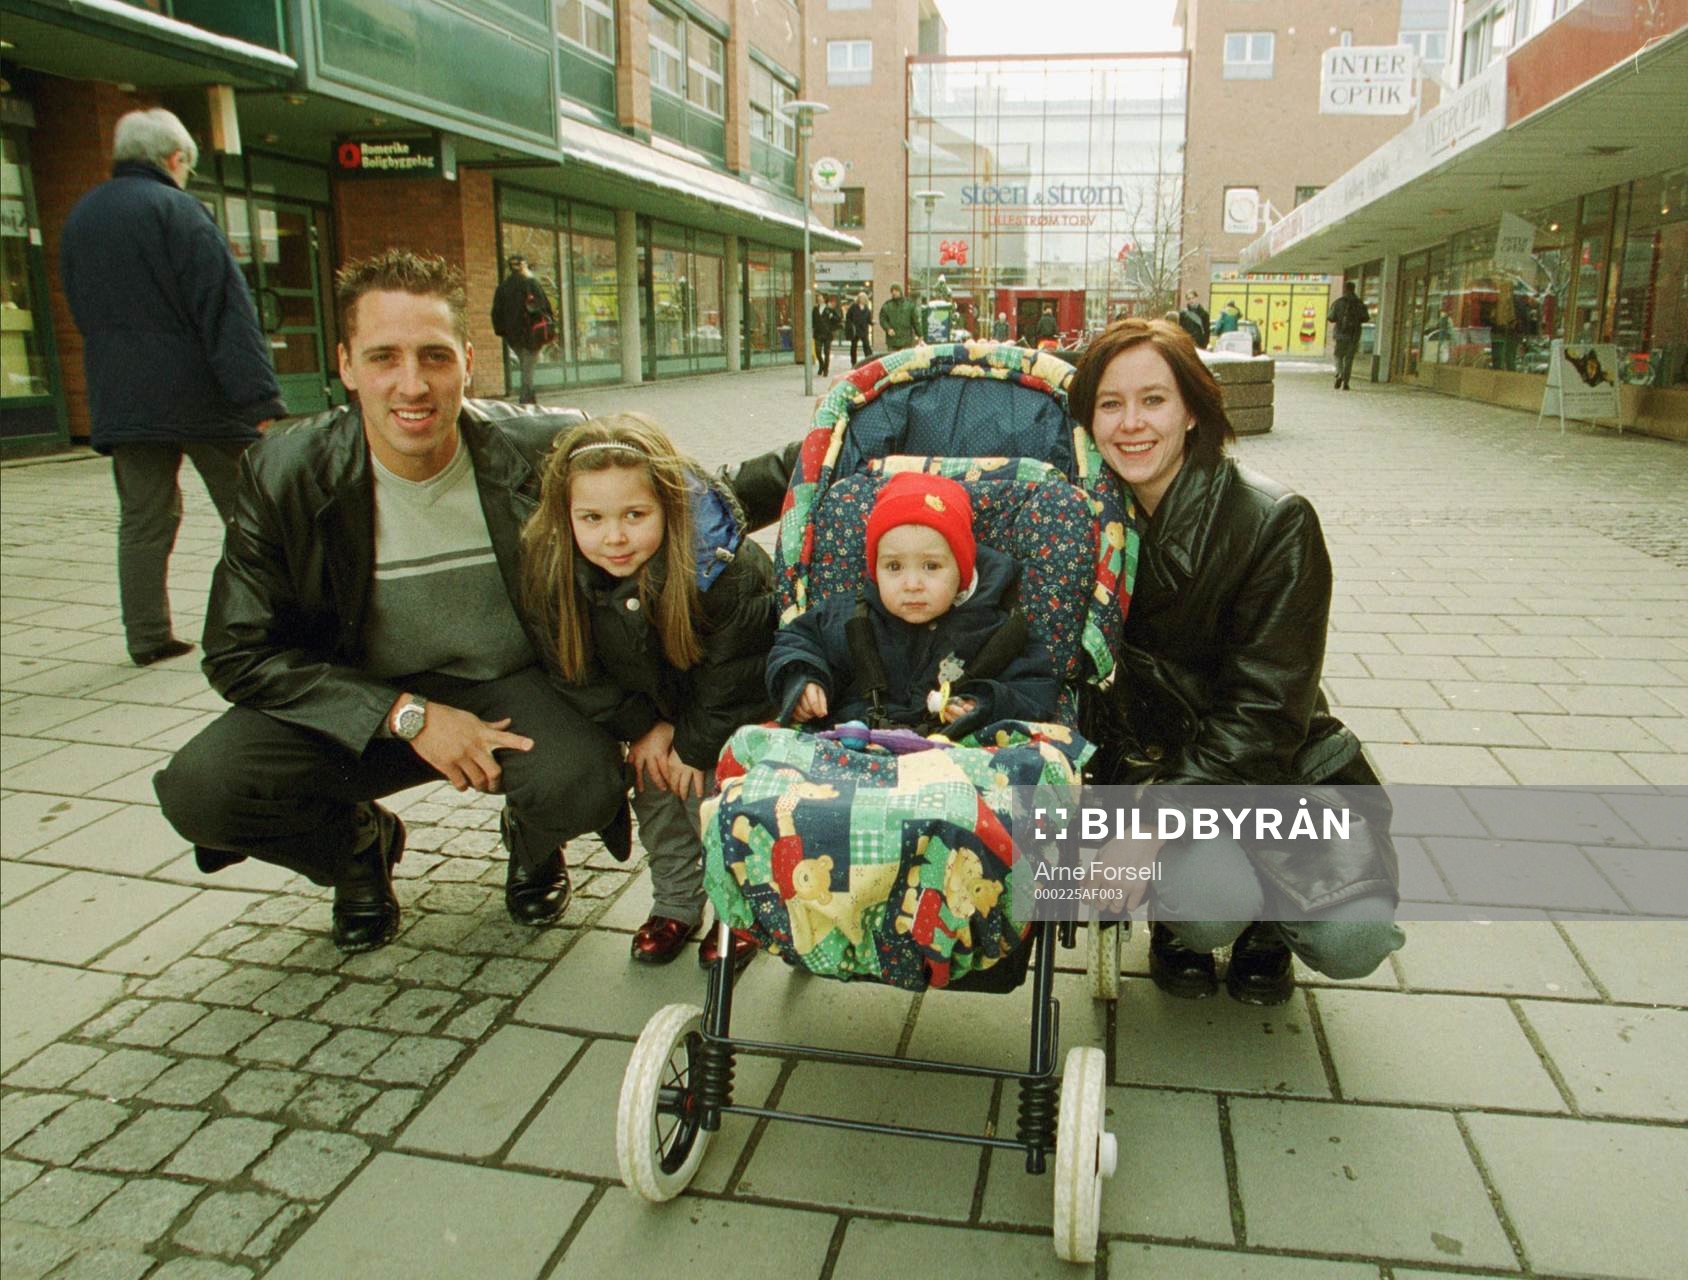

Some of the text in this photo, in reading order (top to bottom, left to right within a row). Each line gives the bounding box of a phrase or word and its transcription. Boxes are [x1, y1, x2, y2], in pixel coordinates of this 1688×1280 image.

[1331, 55, 1406, 75] INTER
[1330, 86, 1401, 105] OPTIK
[361, 142, 410, 155] Romerike
[1033, 190, 1044, 205] &
[1048, 182, 1124, 205] strøm
[1062, 214, 1097, 227] TORV
